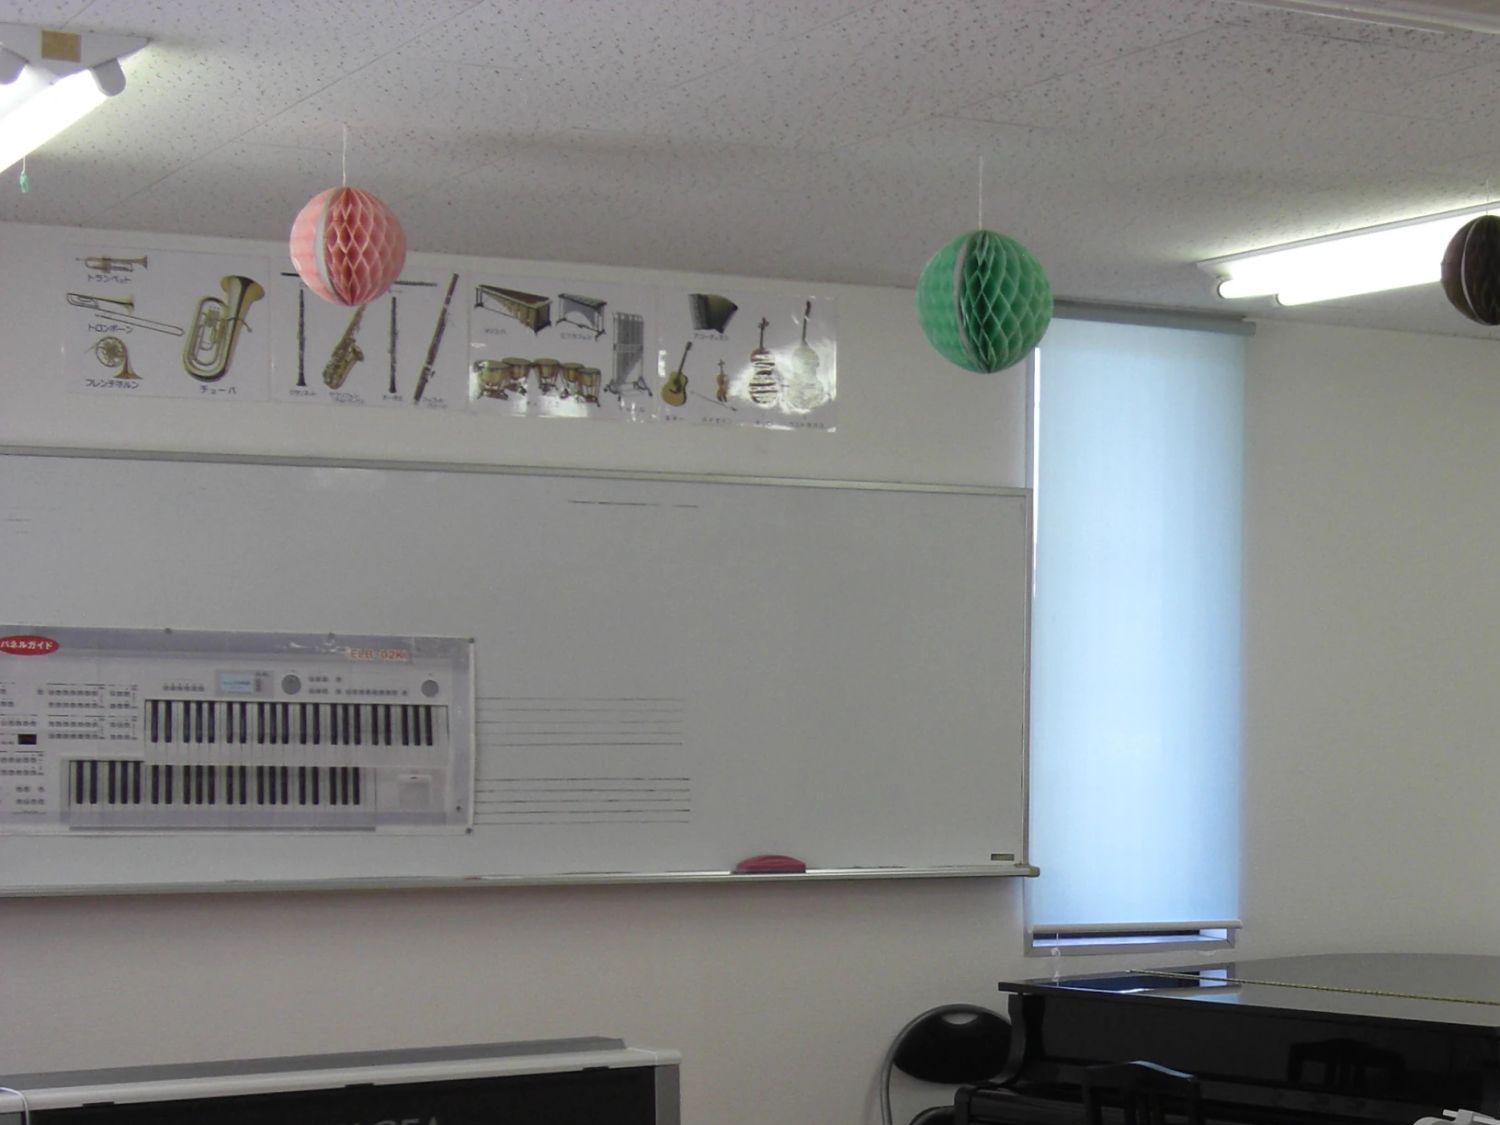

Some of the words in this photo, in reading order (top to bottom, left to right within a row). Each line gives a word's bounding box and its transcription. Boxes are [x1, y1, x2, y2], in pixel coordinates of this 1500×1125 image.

[0, 640, 54, 650] パネルガイド
